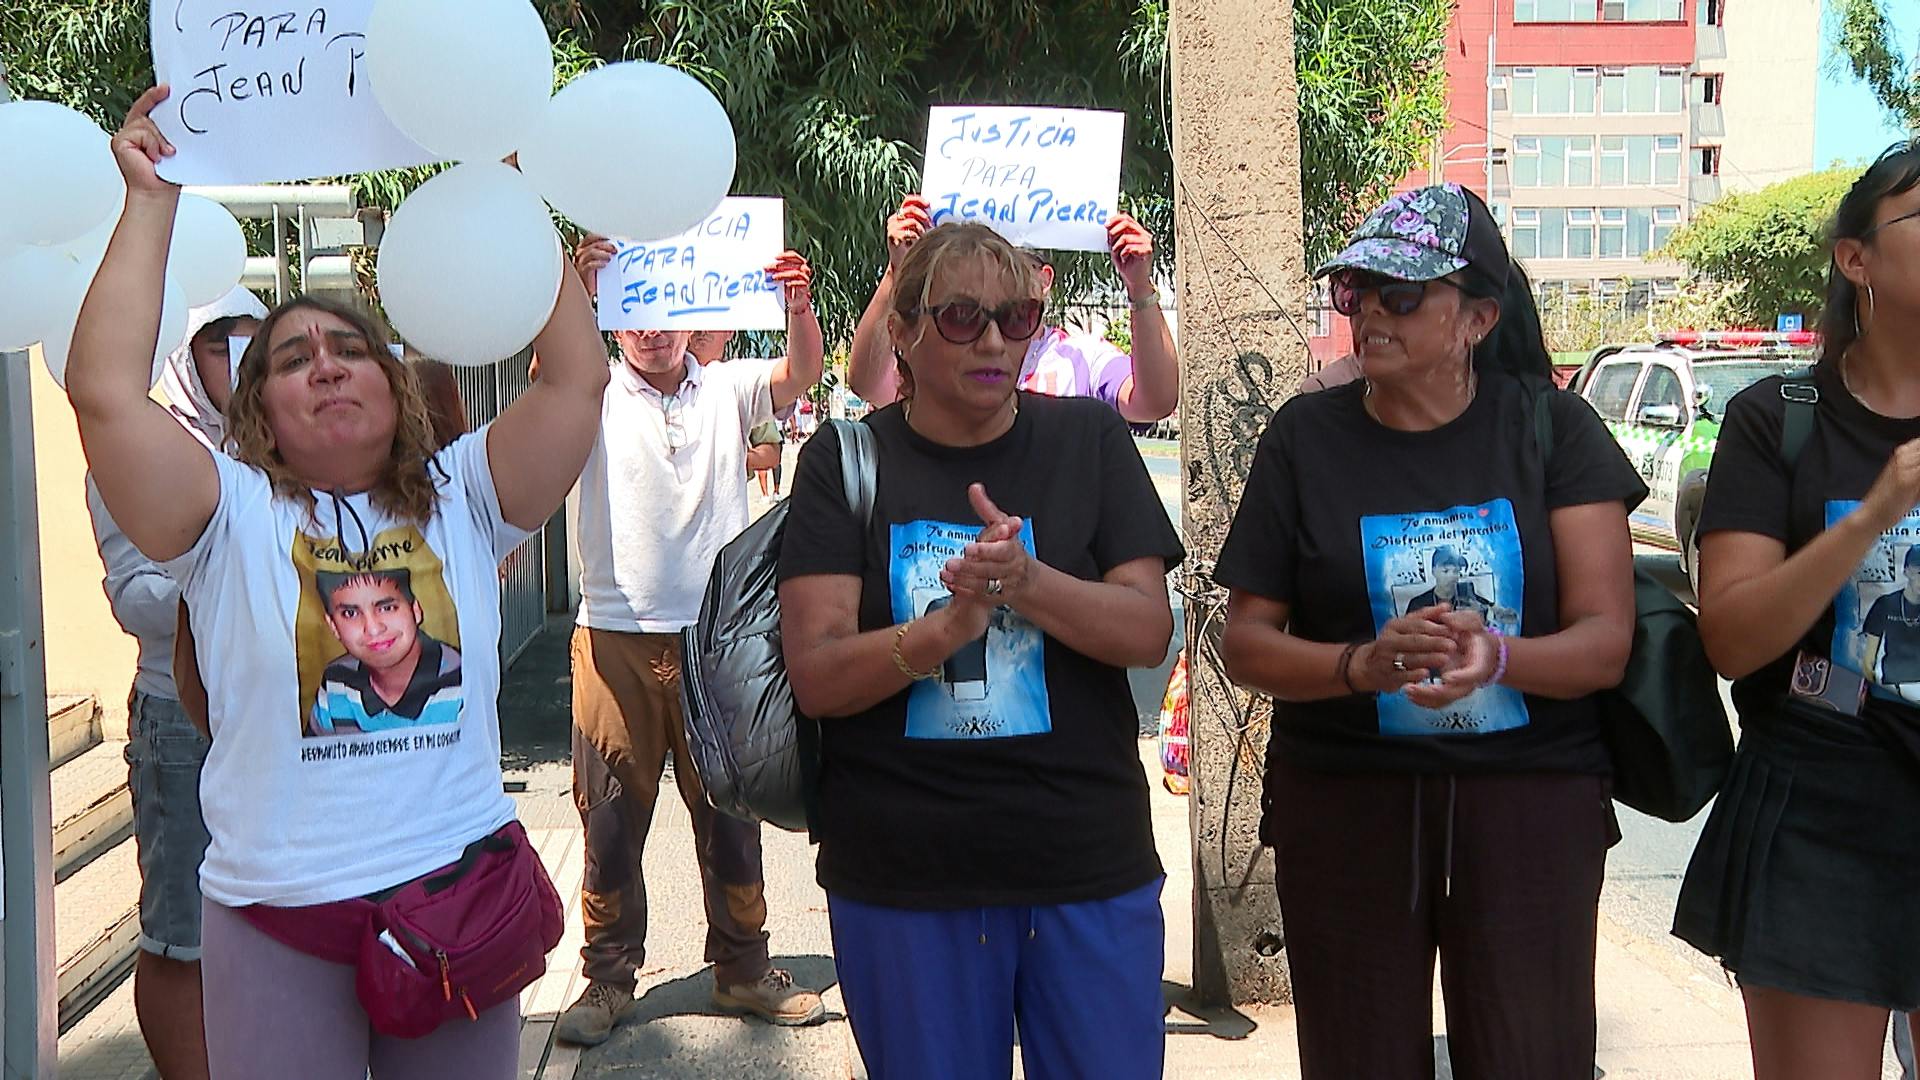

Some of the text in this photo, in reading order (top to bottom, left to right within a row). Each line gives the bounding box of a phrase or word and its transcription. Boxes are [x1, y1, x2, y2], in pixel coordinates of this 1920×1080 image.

[210, 8, 325, 50] PARA
[962, 156, 1036, 189] PARA
[617, 245, 695, 274] PARA
